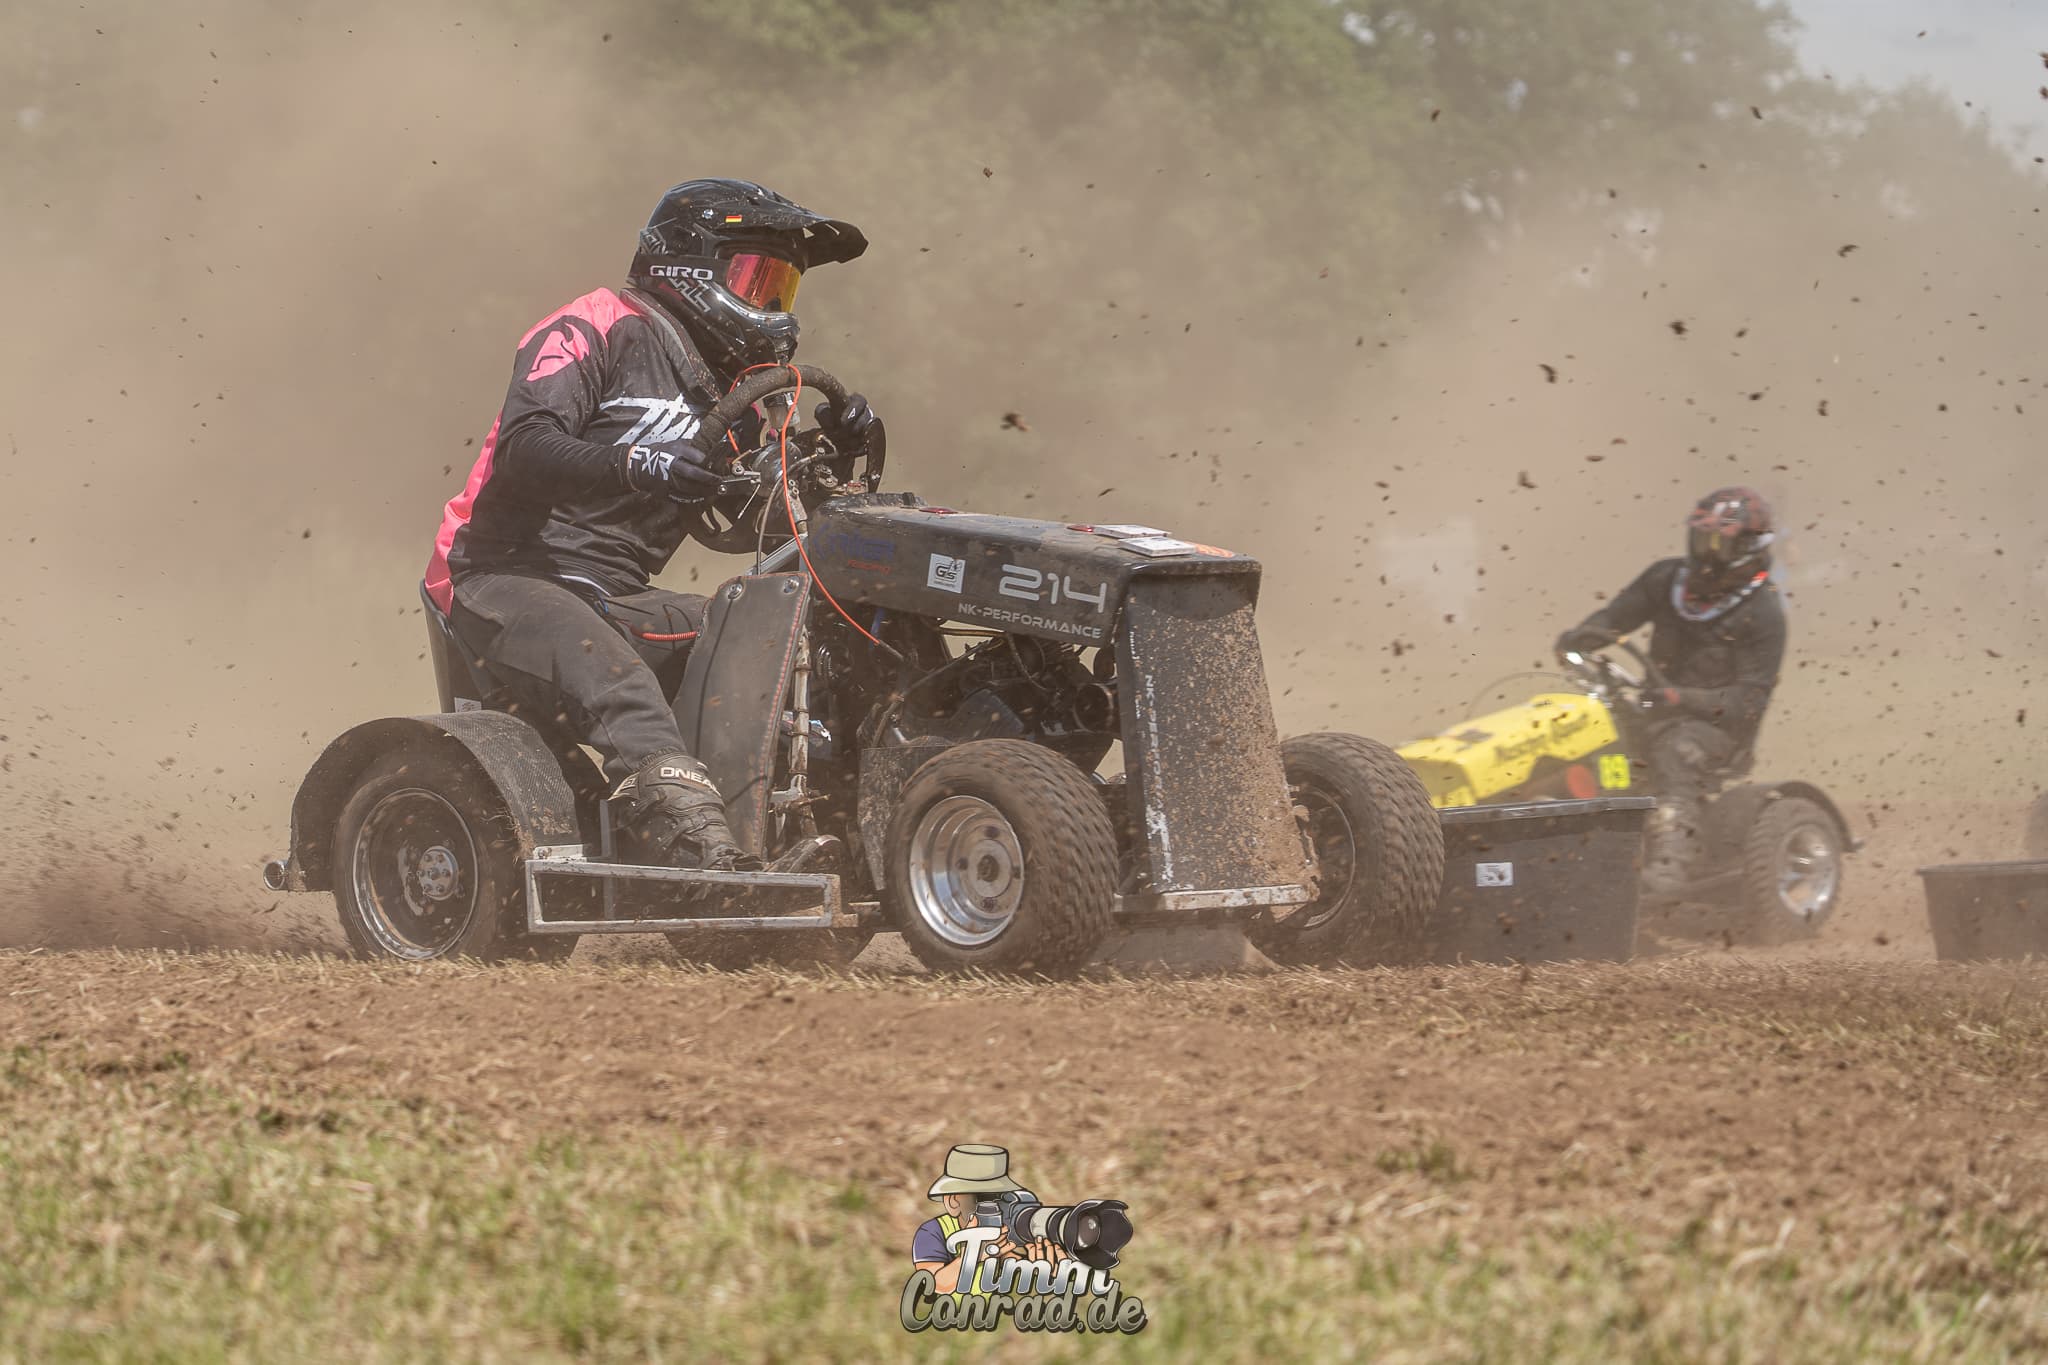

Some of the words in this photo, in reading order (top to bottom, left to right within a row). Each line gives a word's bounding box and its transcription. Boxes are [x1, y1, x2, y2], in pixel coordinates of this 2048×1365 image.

[649, 265, 713, 280] GIRO
[628, 445, 675, 481] FXR
[999, 564, 1107, 614] 214
[958, 602, 1102, 639] NK-PERFORMANCE
